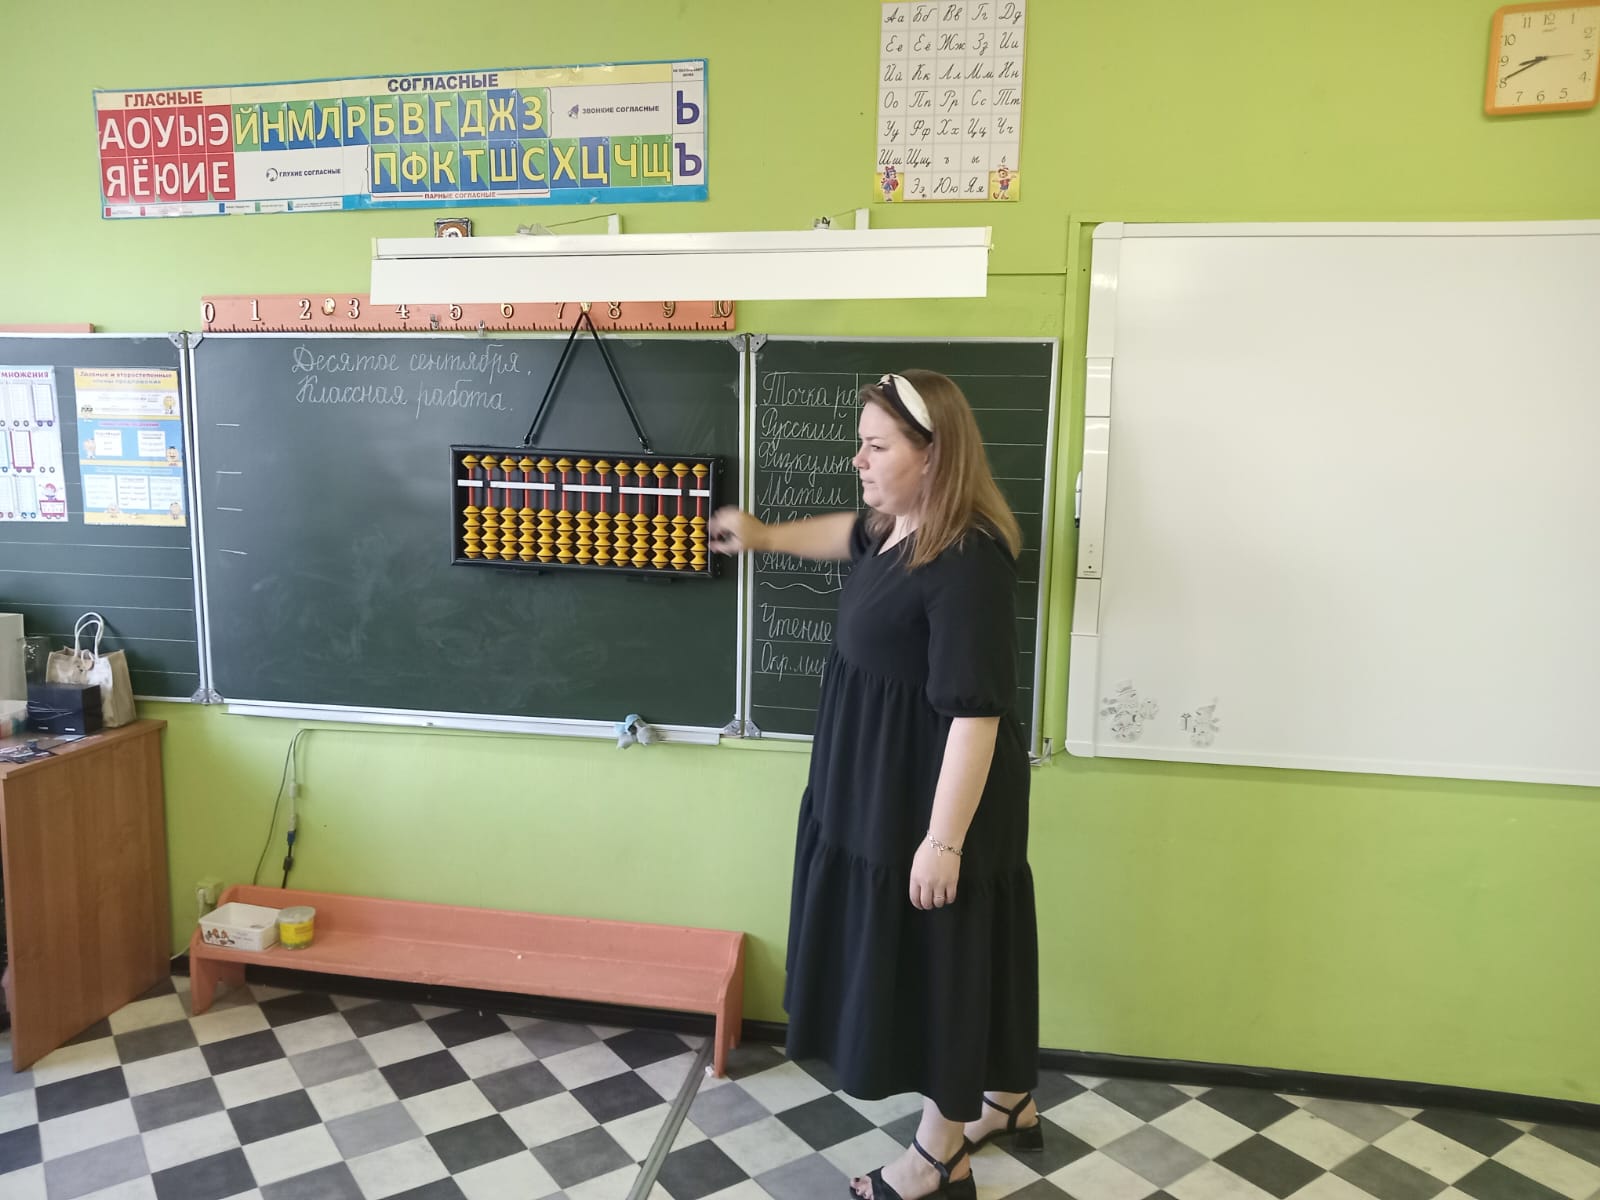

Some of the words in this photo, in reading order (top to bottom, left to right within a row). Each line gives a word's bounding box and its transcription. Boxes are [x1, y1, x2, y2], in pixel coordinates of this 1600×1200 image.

[884, 8, 904, 23] Аа
[912, 5, 937, 22] Бб
[943, 4, 963, 22] Вв
[971, 3, 990, 21] Гг
[998, 3, 1022, 24] Дд
[1544, 12, 1556, 26] 12
[1523, 16, 1532, 29] 11
[1504, 33, 1516, 46] 10
[1583, 26, 1593, 39] 2
[886, 35, 904, 52] Ее
[937, 33, 966, 51] Жж
[972, 33, 989, 56] Зз
[1000, 32, 1019, 49] Ии
[1500, 55, 1509, 67] 9
[911, 64, 931, 81] Кк
[939, 63, 961, 80] Лл
[965, 62, 994, 80] Мм
[998, 61, 1019, 79] Нн
[1578, 71, 1587, 83] 4
[387, 73, 499, 95] СОГЛАСНЫЕ
[1499, 77, 1507, 89] 8
[124, 91, 203, 108] ГЛАСНЫЕ
[884, 90, 899, 109] Оо
[909, 90, 932, 108] Пп
[939, 90, 959, 113] Рр
[971, 89, 988, 106] Сс
[993, 88, 1021, 106] Тт
[1516, 91, 1524, 103] 7
[1536, 90, 1545, 102] 6
[1559, 87, 1568, 99] 5
[616, 105, 660, 113] СОГЛАСНЫЕ
[884, 120, 900, 143] Уу
[910, 119, 931, 141] Фф
[937, 118, 960, 136] Хх
[967, 118, 987, 139] Цц
[998, 117, 1014, 134] Чч
[879, 148, 903, 166] Шш
[906, 148, 932, 169] Щщ
[303, 168, 341, 176] СОГЛАСНЫЕ
[911, 177, 925, 194] Ээ
[934, 176, 959, 194] Юю
[964, 176, 985, 194] Яя
[454, 191, 496, 199] СОГЛАСНЫЕ
[202, 301, 215, 324] 0
[250, 299, 261, 322] 1
[299, 298, 313, 320] 2
[348, 298, 361, 319] 3
[395, 303, 409, 319] 4
[449, 304, 463, 320] 5
[500, 303, 514, 319] 6
[555, 302, 566, 319] 7
[607, 301, 622, 319] 8
[662, 301, 676, 318] 9
[710, 300, 734, 318] 10
[291, 343, 400, 374] Десятое
[295, 375, 408, 405] Классная
[415, 379, 513, 420] работа.
[762, 371, 831, 407] Точка
[761, 408, 847, 451] Русский
[760, 603, 833, 642] Чтение
